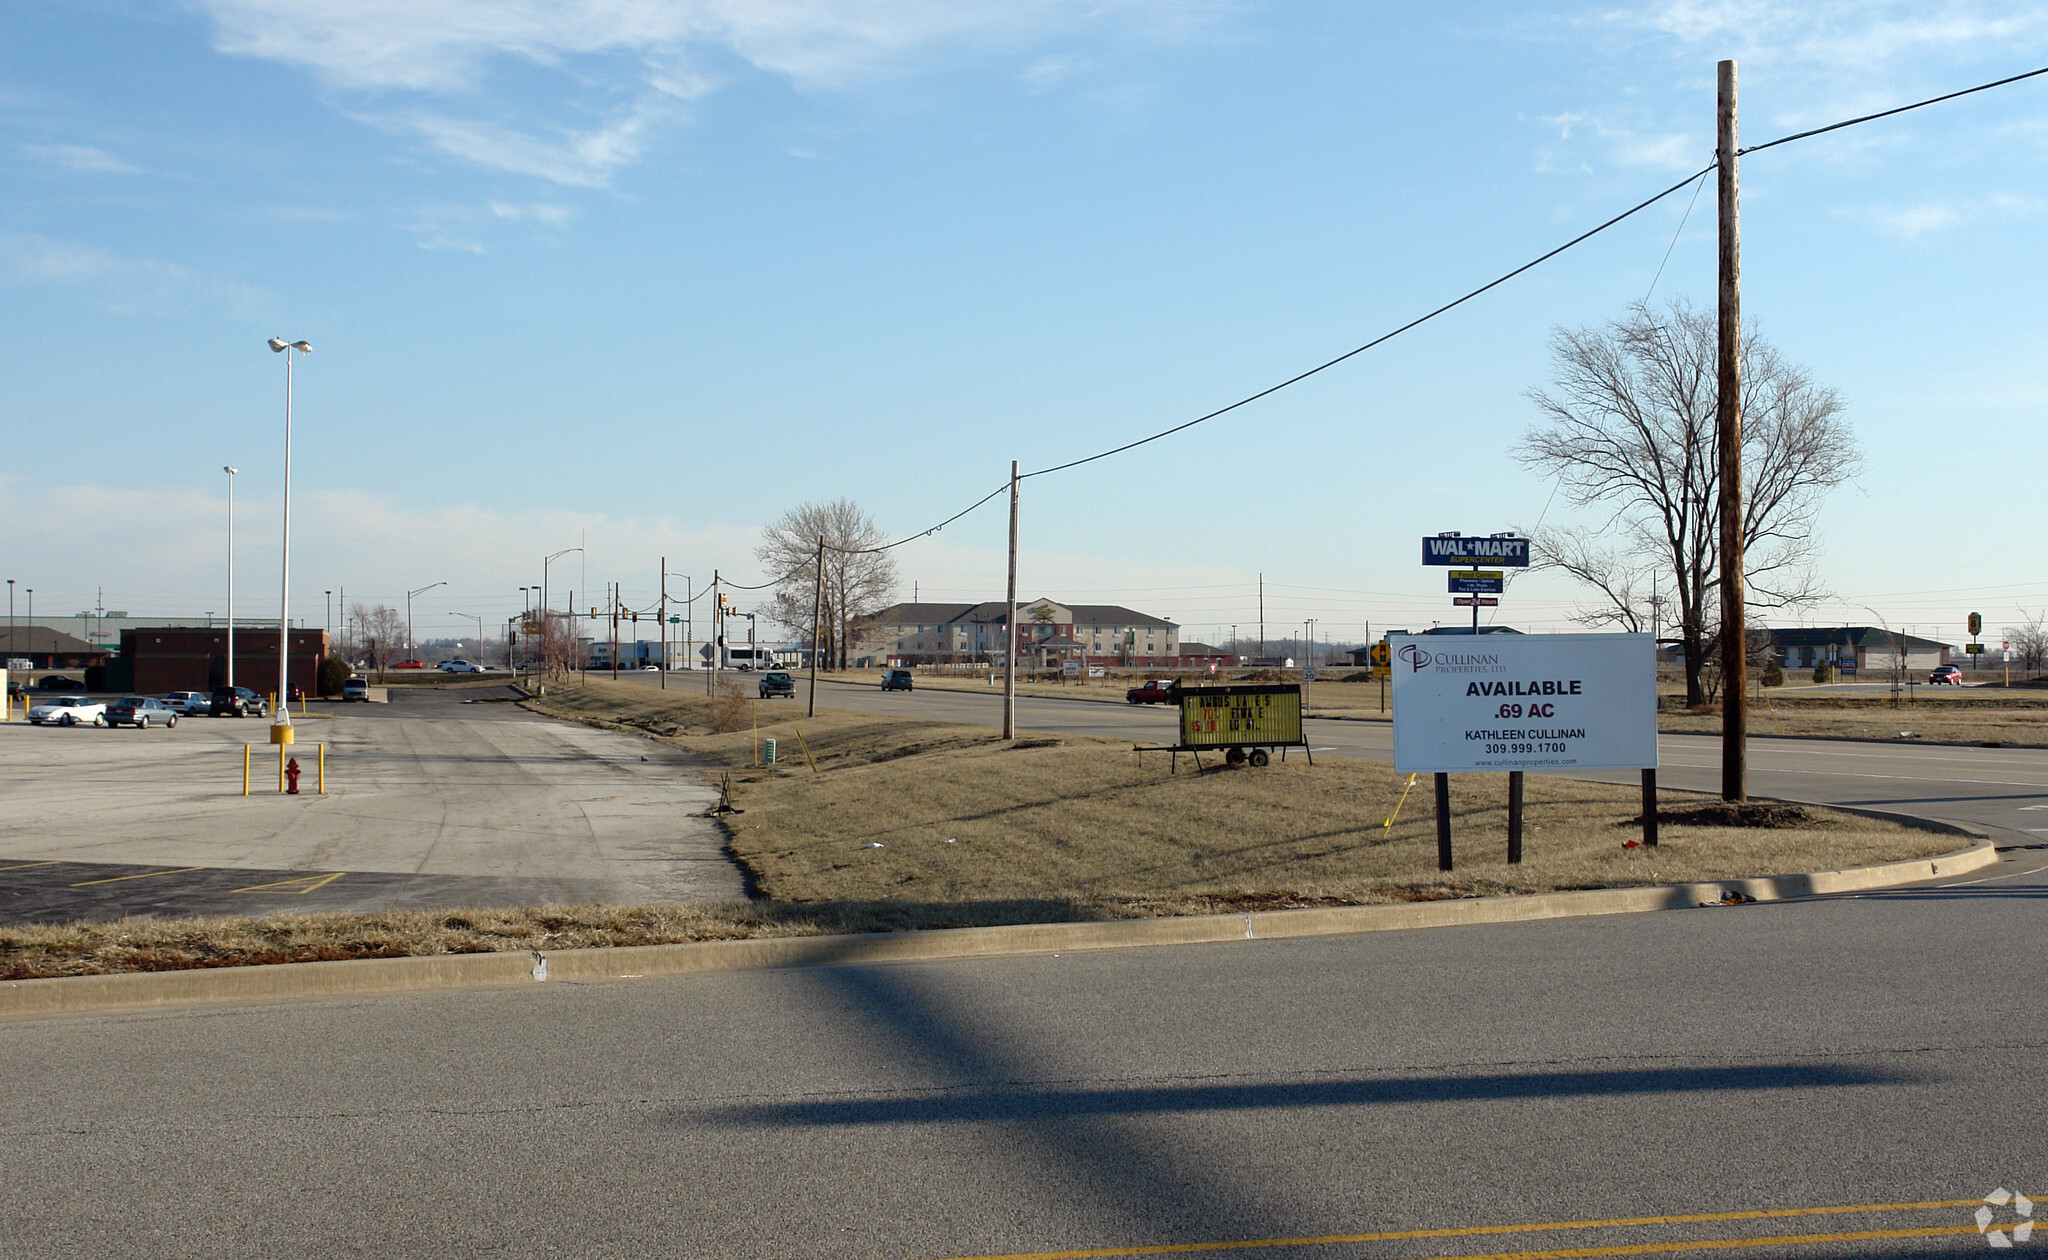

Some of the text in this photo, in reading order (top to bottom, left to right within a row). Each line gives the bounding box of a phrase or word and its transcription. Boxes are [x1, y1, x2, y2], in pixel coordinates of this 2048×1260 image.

[1435, 653, 1498, 664] CULLINAN
[1466, 680, 1582, 696] AVAILABLE
[1494, 703, 1555, 718] .69 AC
[1465, 728, 1585, 740] KATHLEEN CULLINAN
[1485, 742, 1566, 754] 309.999.1700
[1474, 758, 1577, 766] www.cullinanproperties.com
